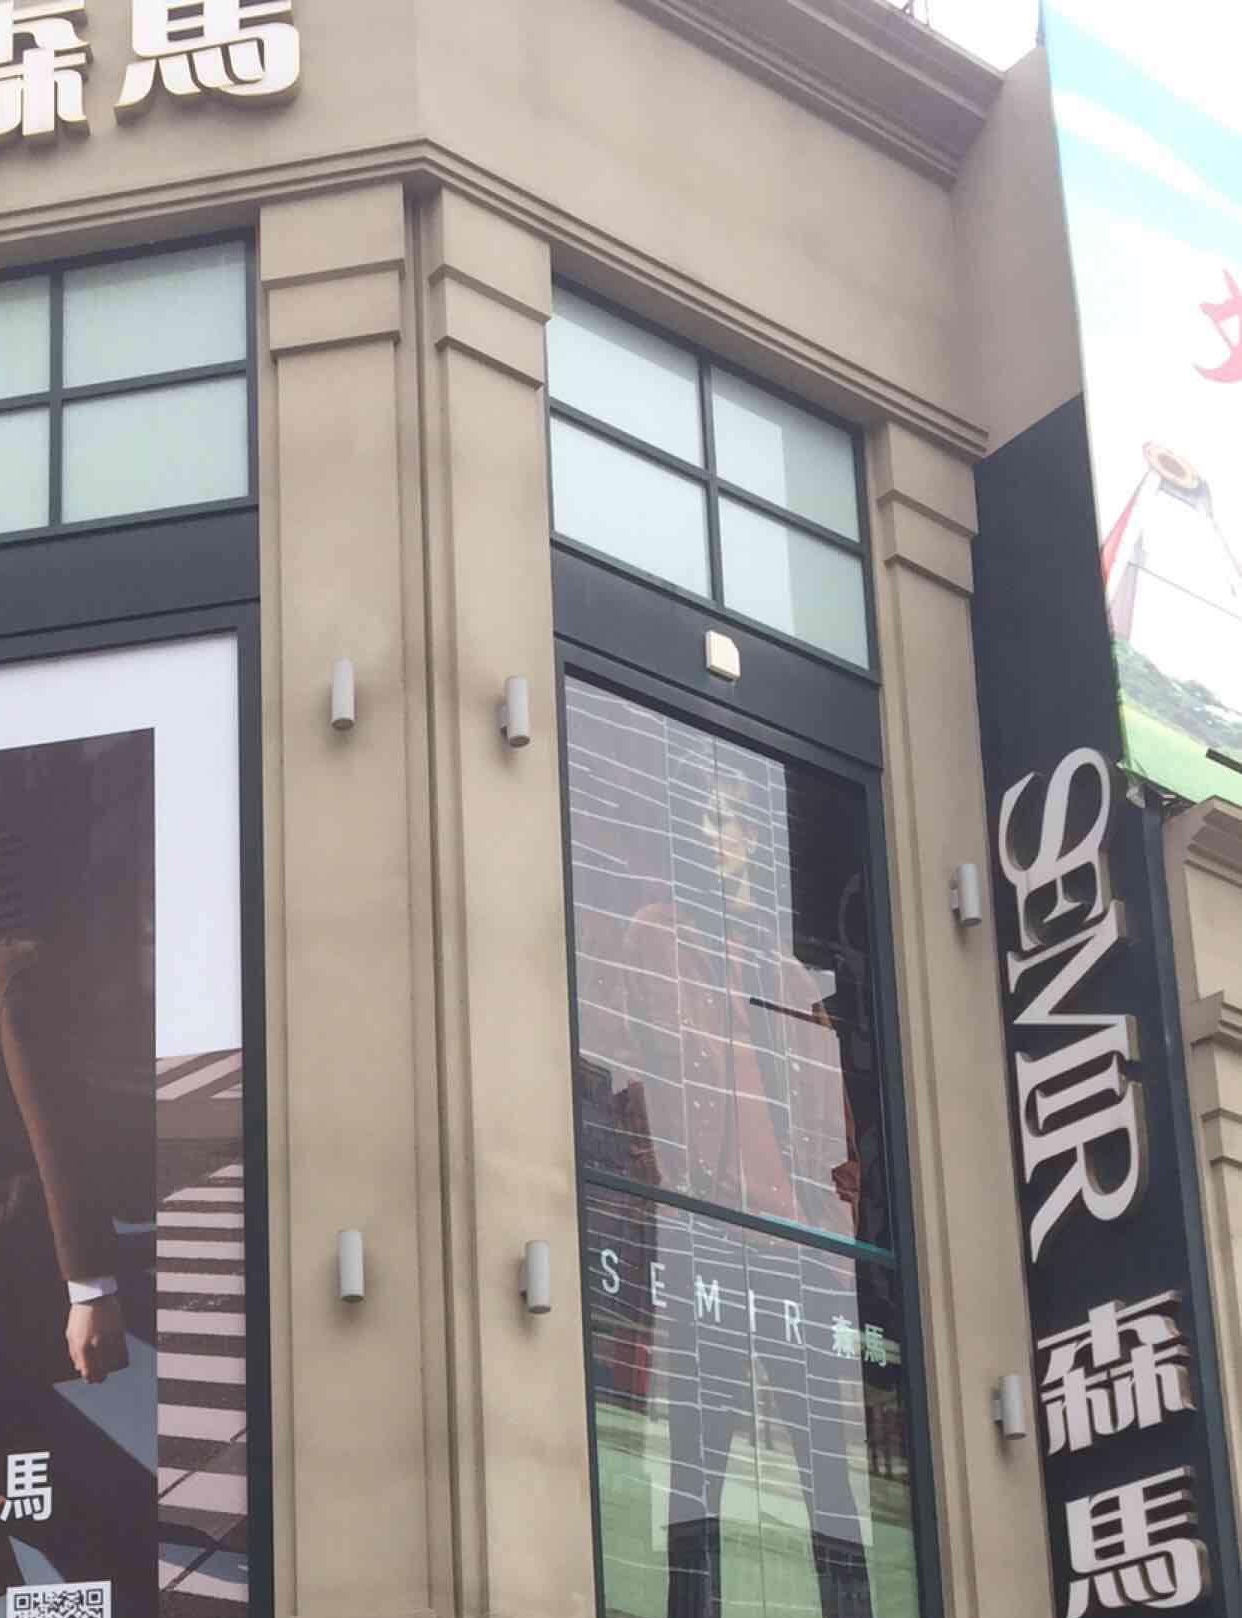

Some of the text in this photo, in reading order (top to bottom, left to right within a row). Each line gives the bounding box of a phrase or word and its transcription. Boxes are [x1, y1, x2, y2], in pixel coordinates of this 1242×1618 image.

[998, 746, 1142, 1264] SEMIR
[599, 1247, 889, 1369] SEMIR 森馬
